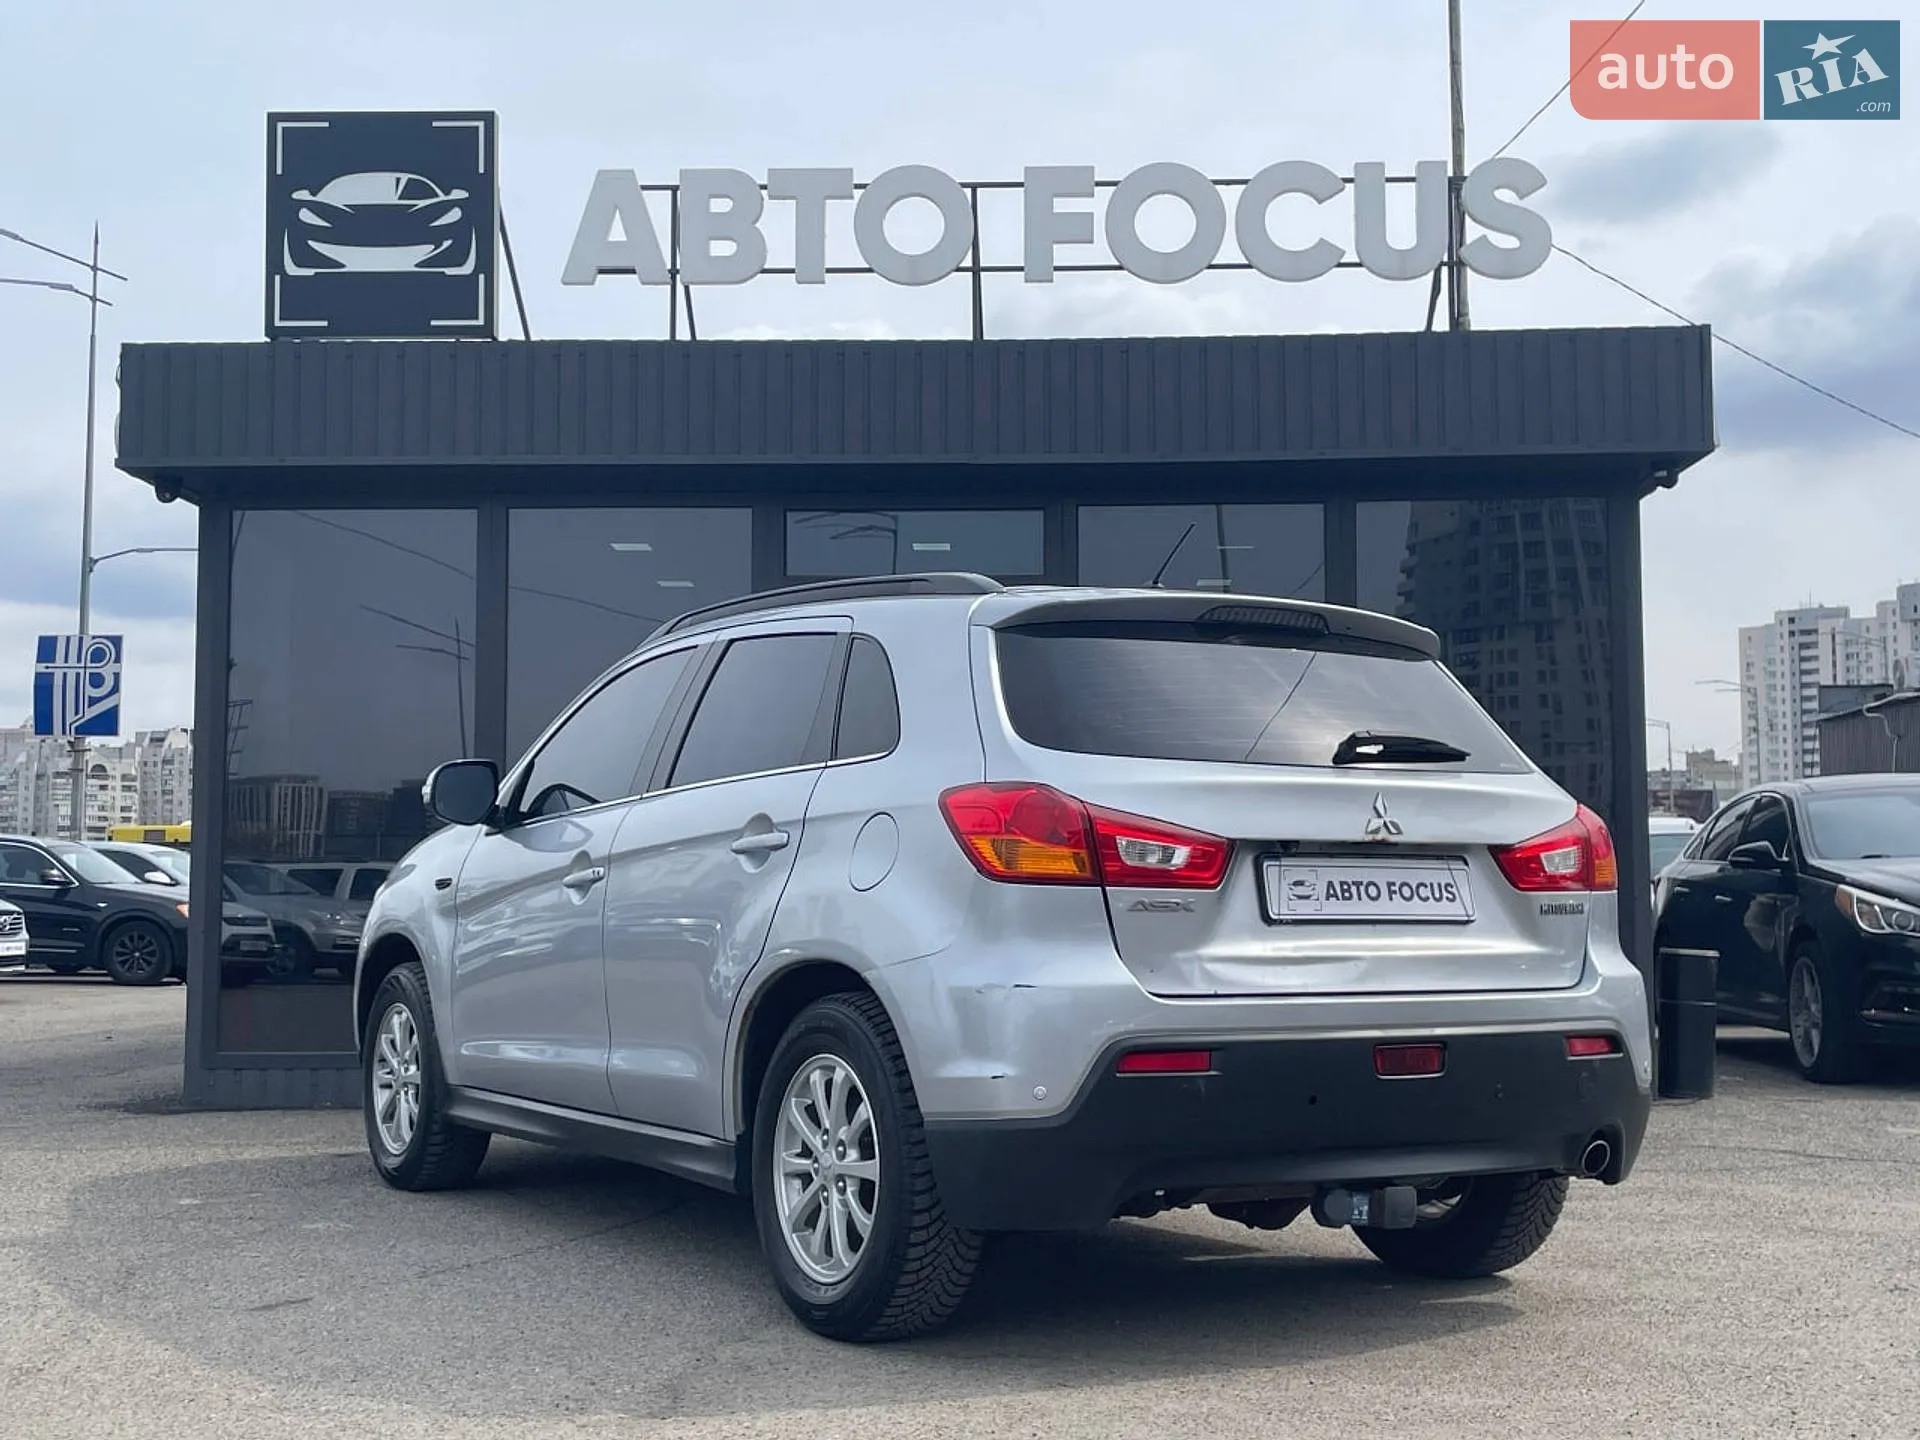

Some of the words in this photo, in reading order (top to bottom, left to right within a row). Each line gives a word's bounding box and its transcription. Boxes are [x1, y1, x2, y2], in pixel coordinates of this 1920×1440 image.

[562, 164, 975, 286] АВТО
[1023, 158, 1553, 285] FOCUS
[1325, 879, 1381, 902] АВТО
[1387, 881, 1457, 903] FOCUS
